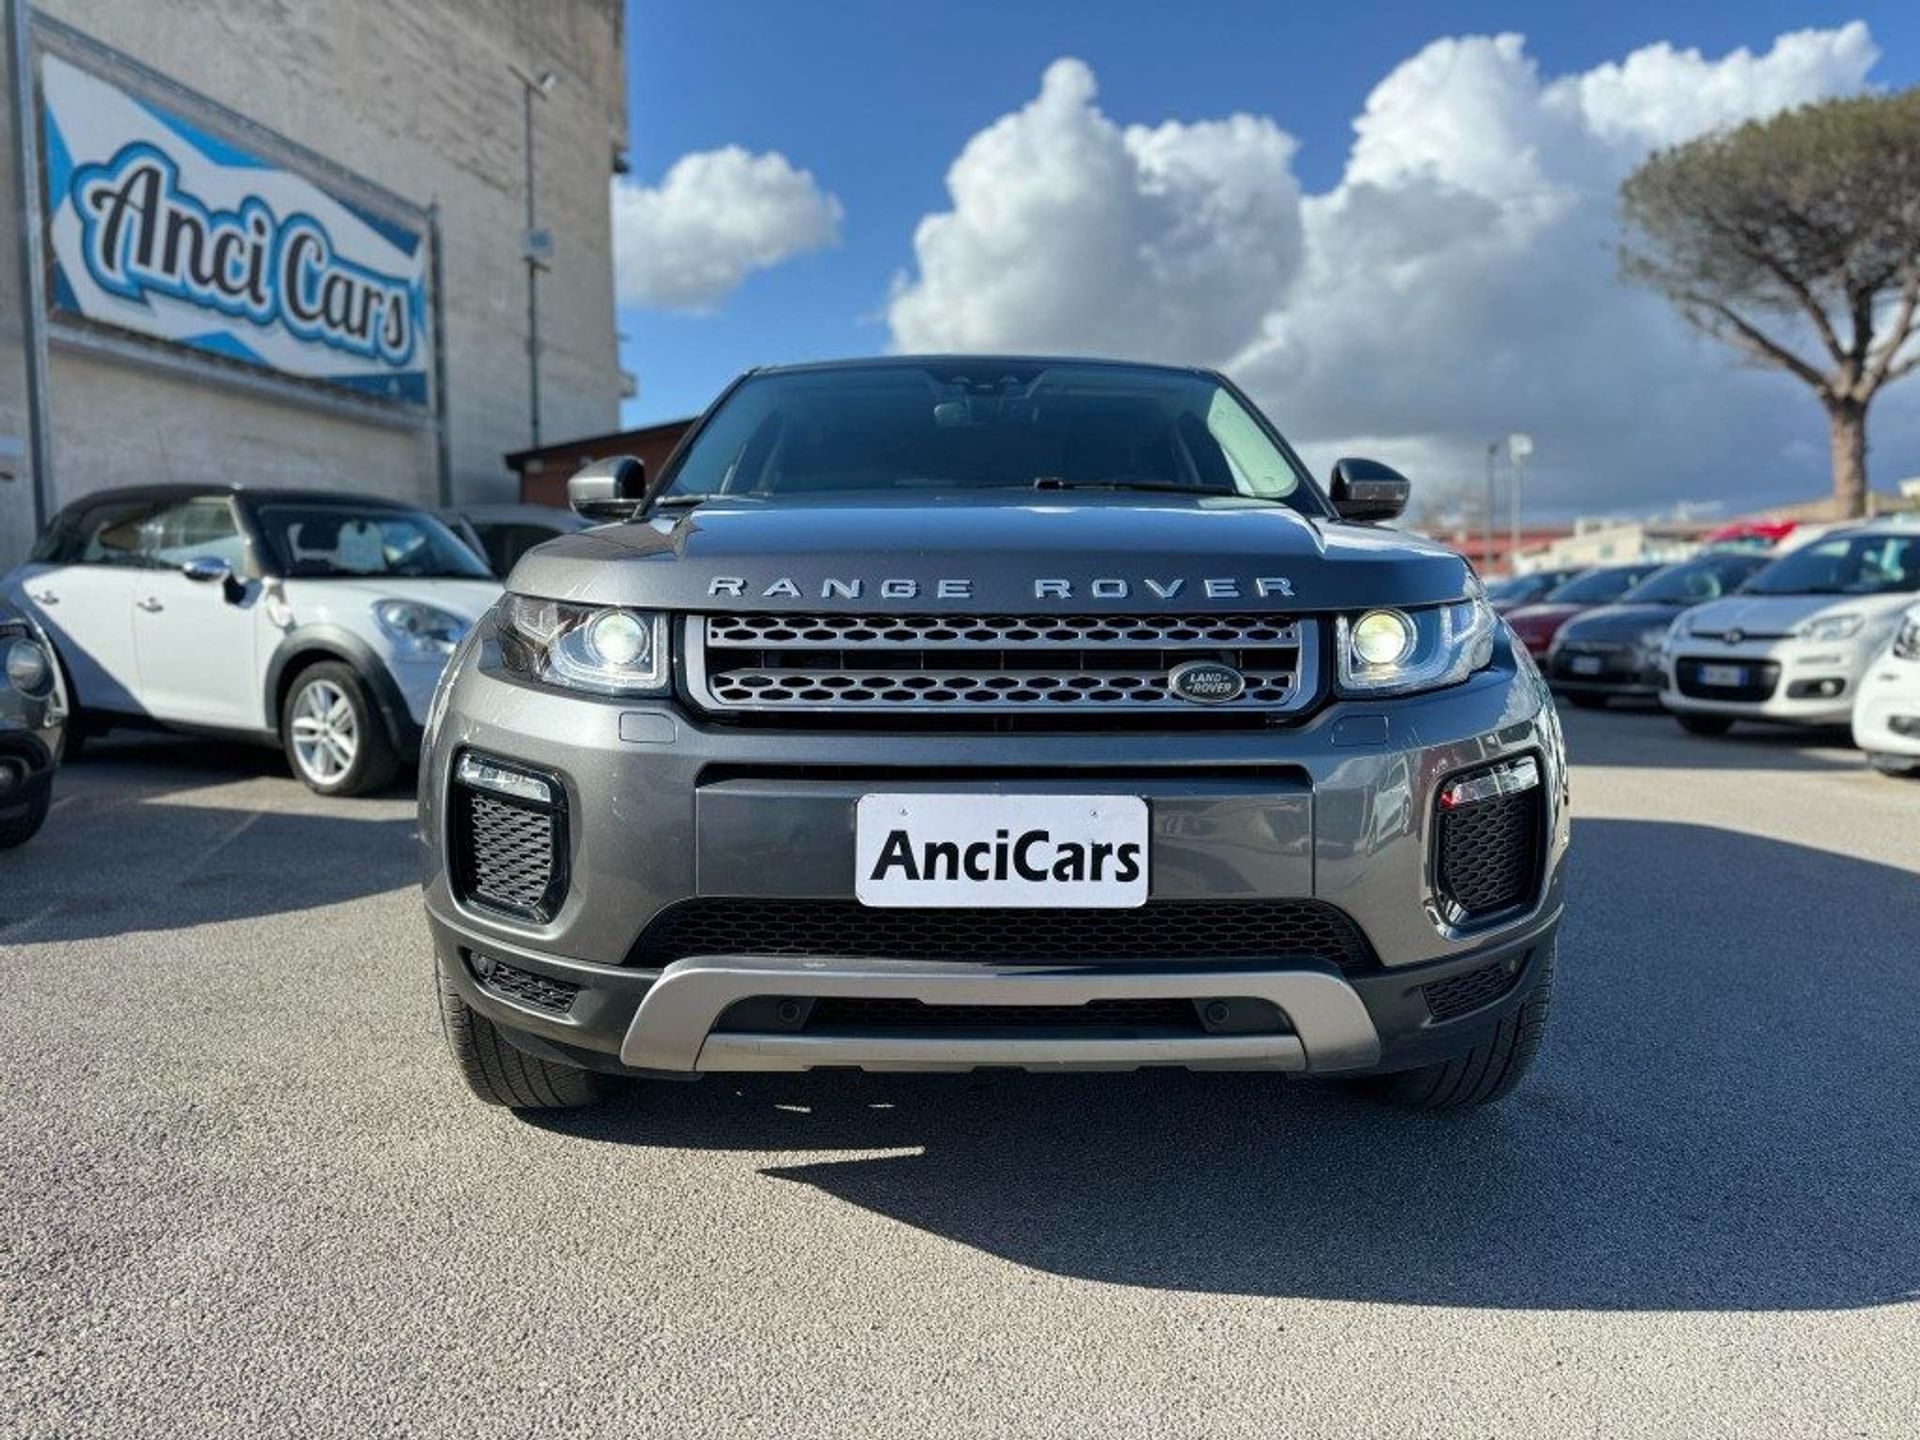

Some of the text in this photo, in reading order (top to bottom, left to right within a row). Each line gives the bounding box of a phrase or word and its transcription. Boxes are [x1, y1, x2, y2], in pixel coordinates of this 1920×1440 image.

[91, 165, 403, 349] Anci Cars
[708, 576, 1296, 599] RANGE ROVER
[870, 829, 1140, 882] AnciCars
